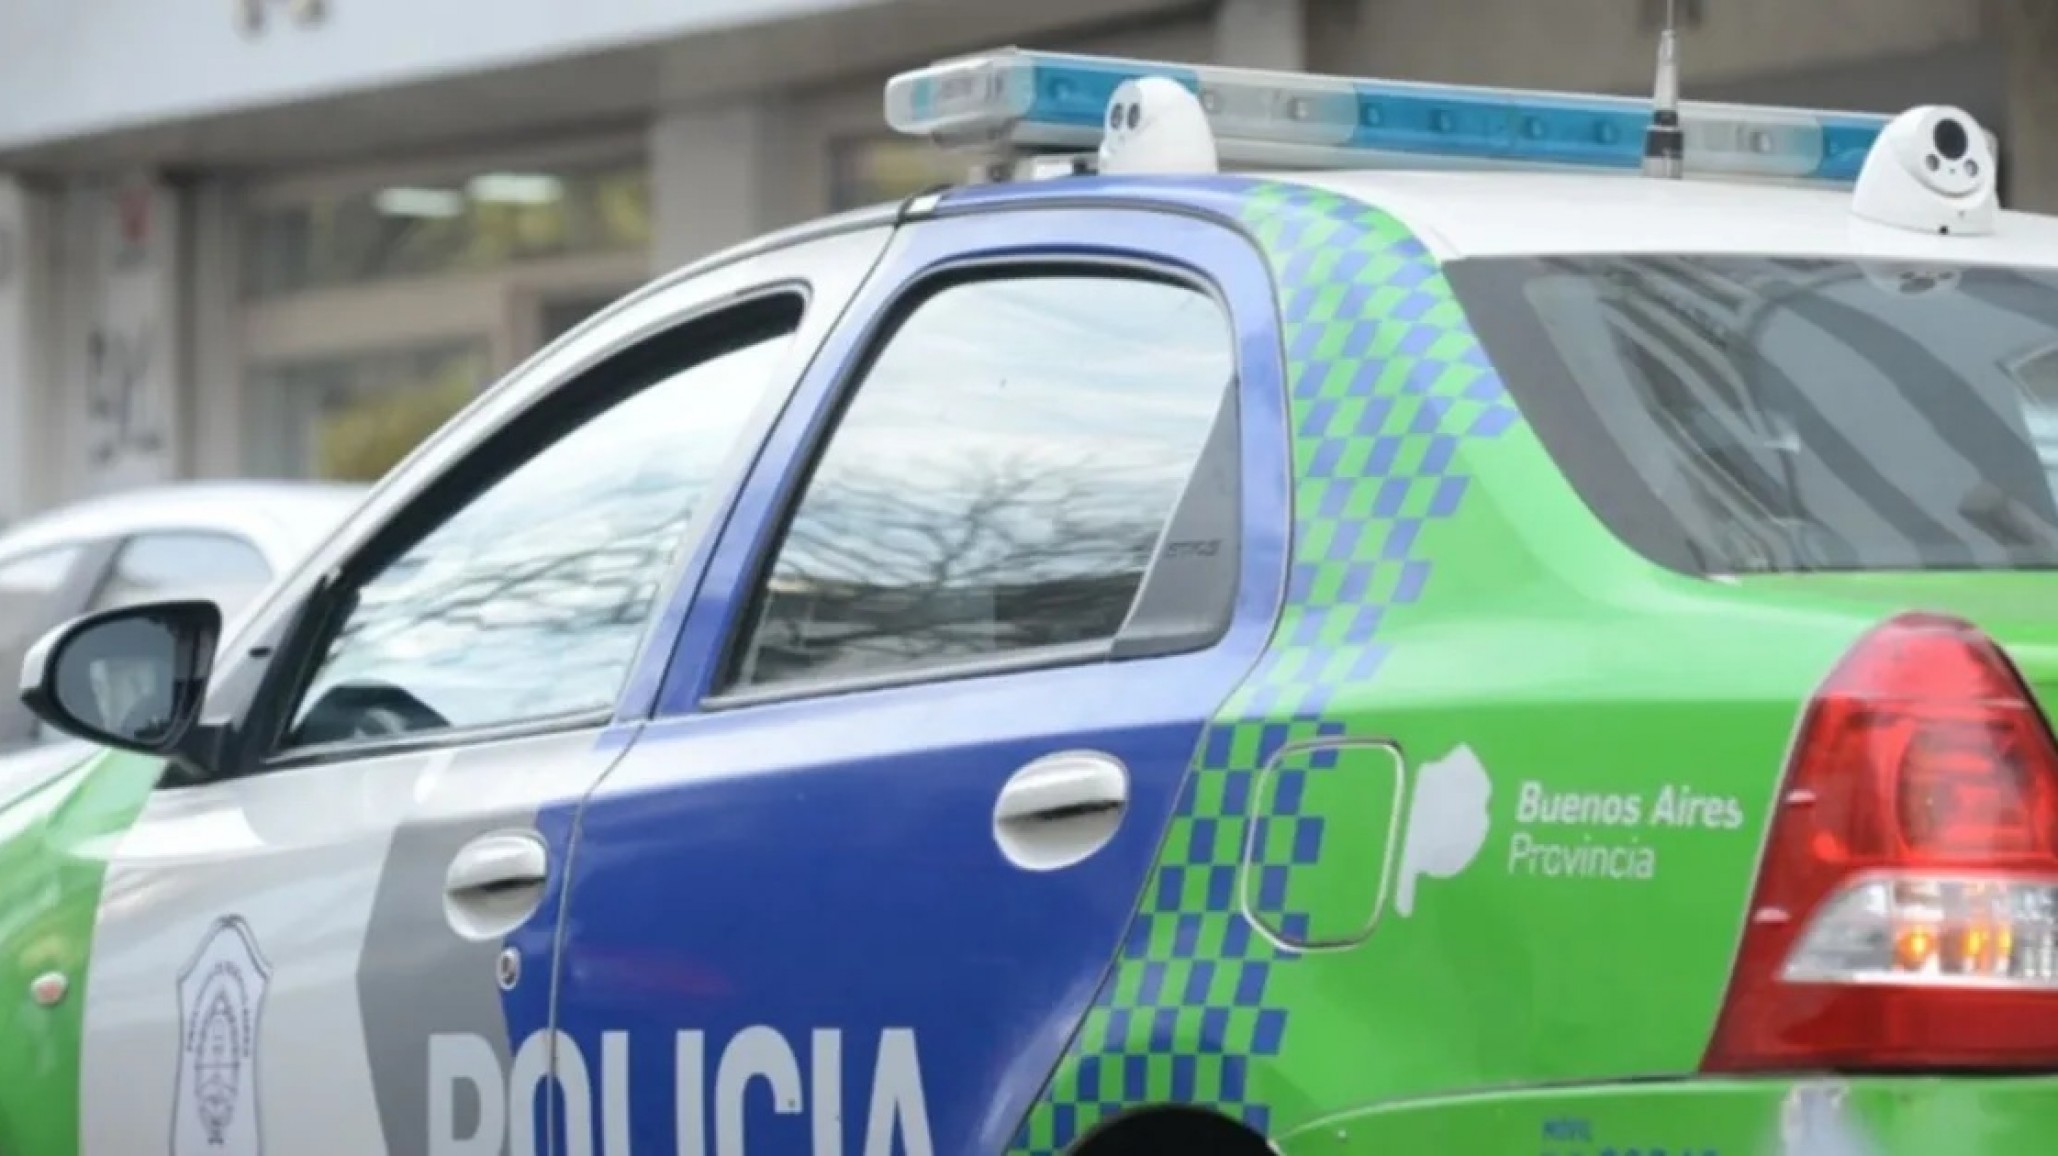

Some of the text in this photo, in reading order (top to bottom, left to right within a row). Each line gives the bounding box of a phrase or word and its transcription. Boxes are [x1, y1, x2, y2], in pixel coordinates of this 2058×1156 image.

[1516, 781, 1744, 829] Buenos Aires
[1508, 832, 1656, 879] Provincia
